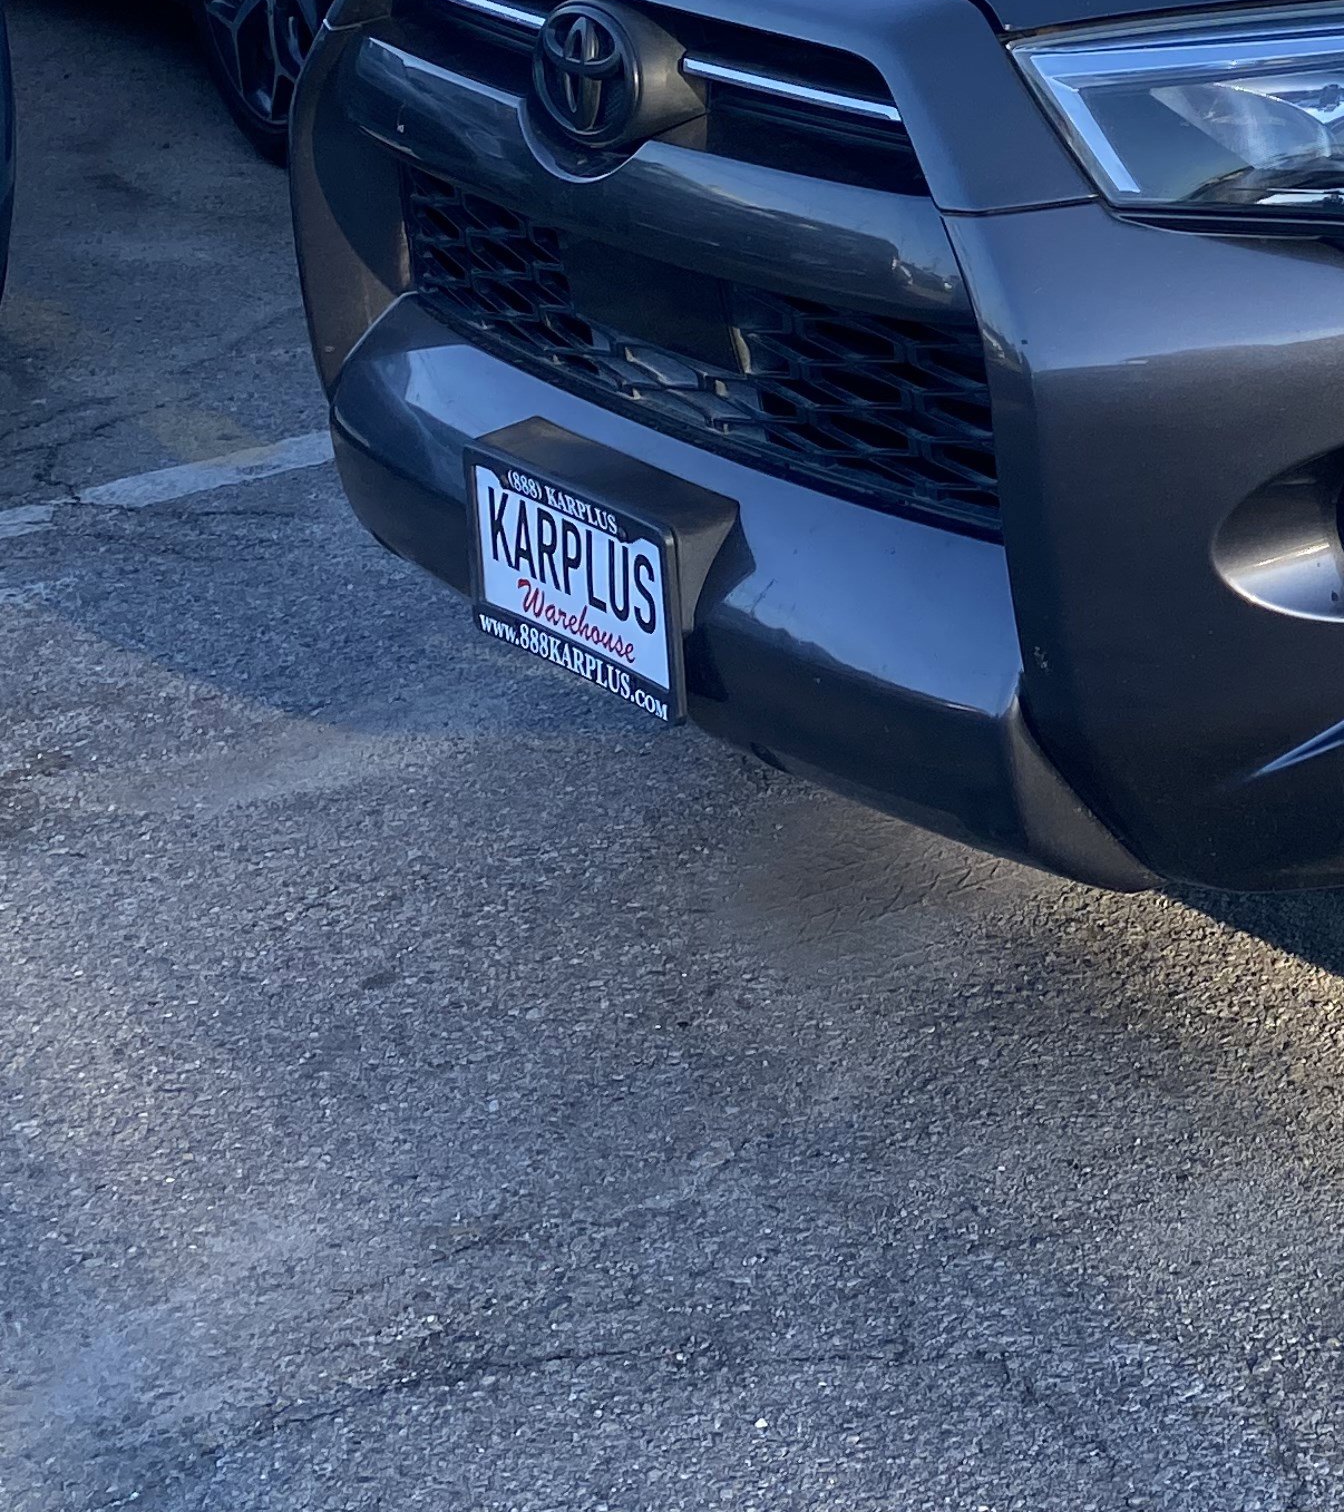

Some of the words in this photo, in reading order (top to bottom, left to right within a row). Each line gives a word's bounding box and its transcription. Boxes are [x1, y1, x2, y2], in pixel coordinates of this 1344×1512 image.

[507, 469, 542, 500] (888)
[544, 485, 618, 536] KARPLUS
[487, 486, 656, 635] KARPLUS
[517, 578, 636, 664] Warehouse
